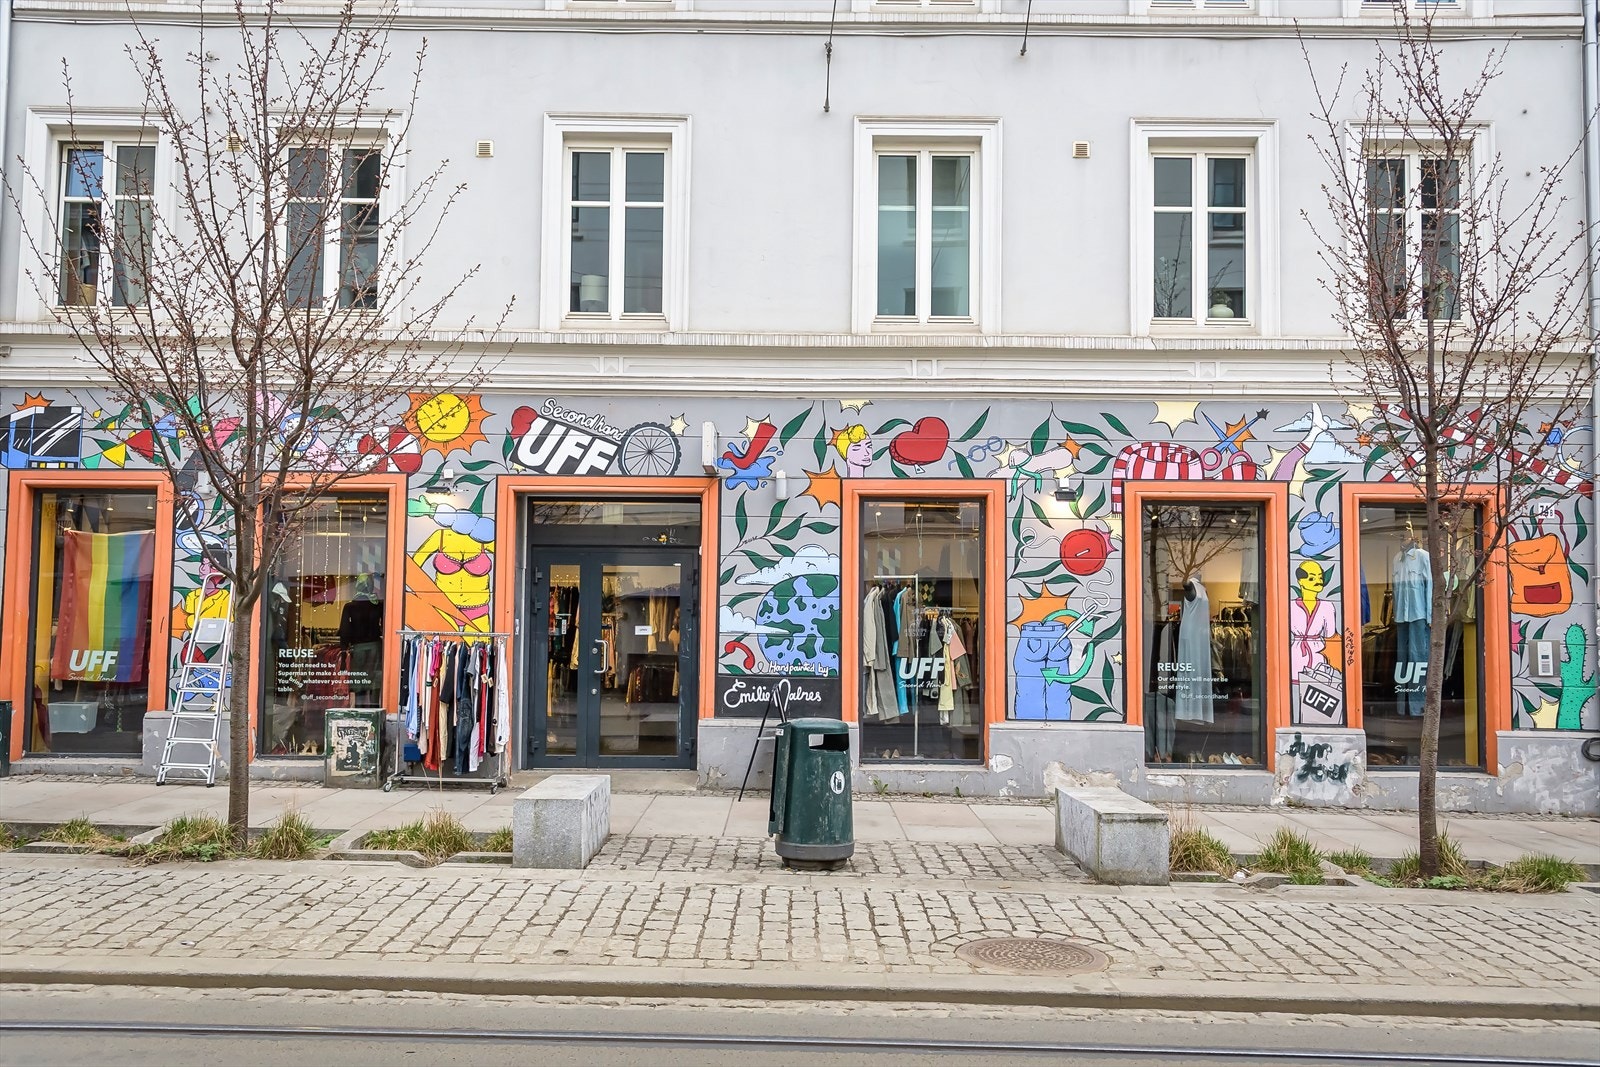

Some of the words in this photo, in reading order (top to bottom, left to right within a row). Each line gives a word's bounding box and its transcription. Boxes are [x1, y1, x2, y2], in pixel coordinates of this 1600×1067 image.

[517, 416, 619, 475] UFF
[69, 649, 118, 672] UFF
[278, 648, 318, 658] REUSE.
[278, 670, 307, 678] Superman
[818, 662, 829, 677] by
[898, 657, 946, 680] UFF
[1157, 662, 1196, 672] REUSE.
[1394, 661, 1429, 684] UF
[68, 672, 94, 681] Second
[97, 673, 117, 681] Hand
[899, 680, 924, 689] Second
[1394, 685, 1420, 693] Second
[723, 679, 771, 708] Emilie
[1305, 688, 1337, 712] UFF
